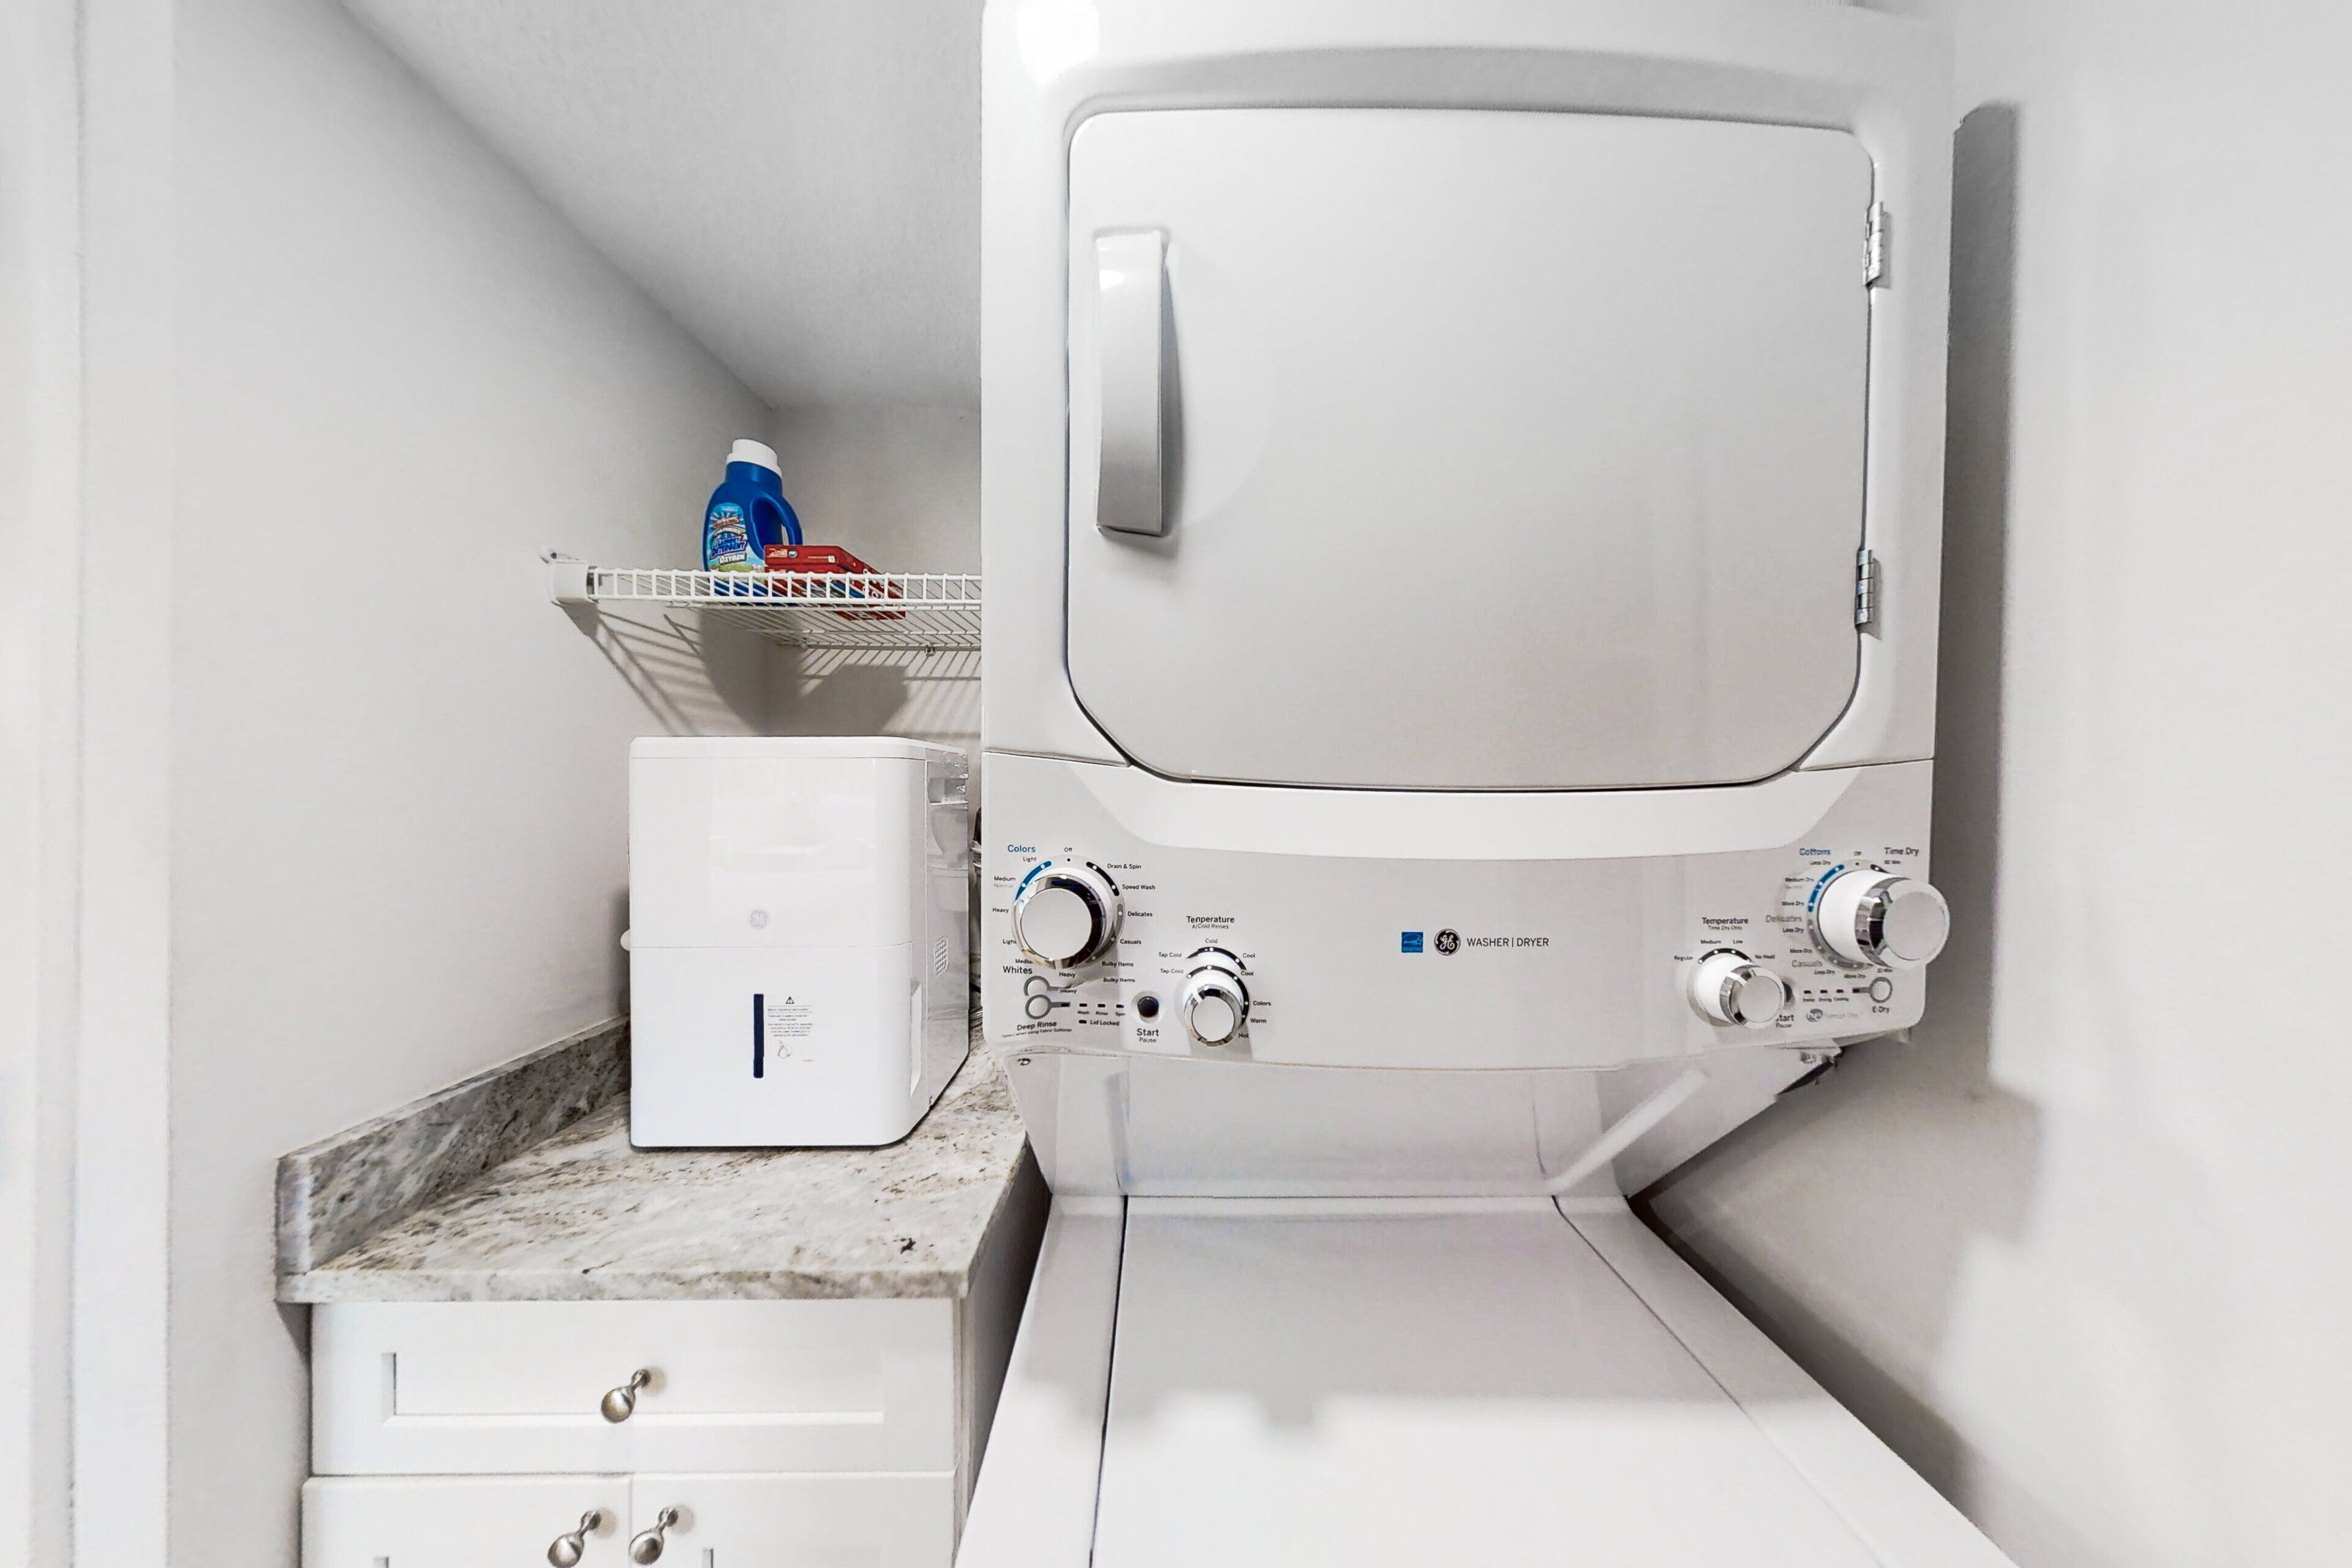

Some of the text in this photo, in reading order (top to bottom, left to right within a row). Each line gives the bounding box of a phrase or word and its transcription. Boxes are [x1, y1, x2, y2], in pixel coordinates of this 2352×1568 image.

[1008, 844, 1036, 853] Colors
[1905, 847, 1920, 856] Dry
[1467, 938, 1549, 946] WASHER DRYER
[1136, 1028, 1159, 1037] Start
